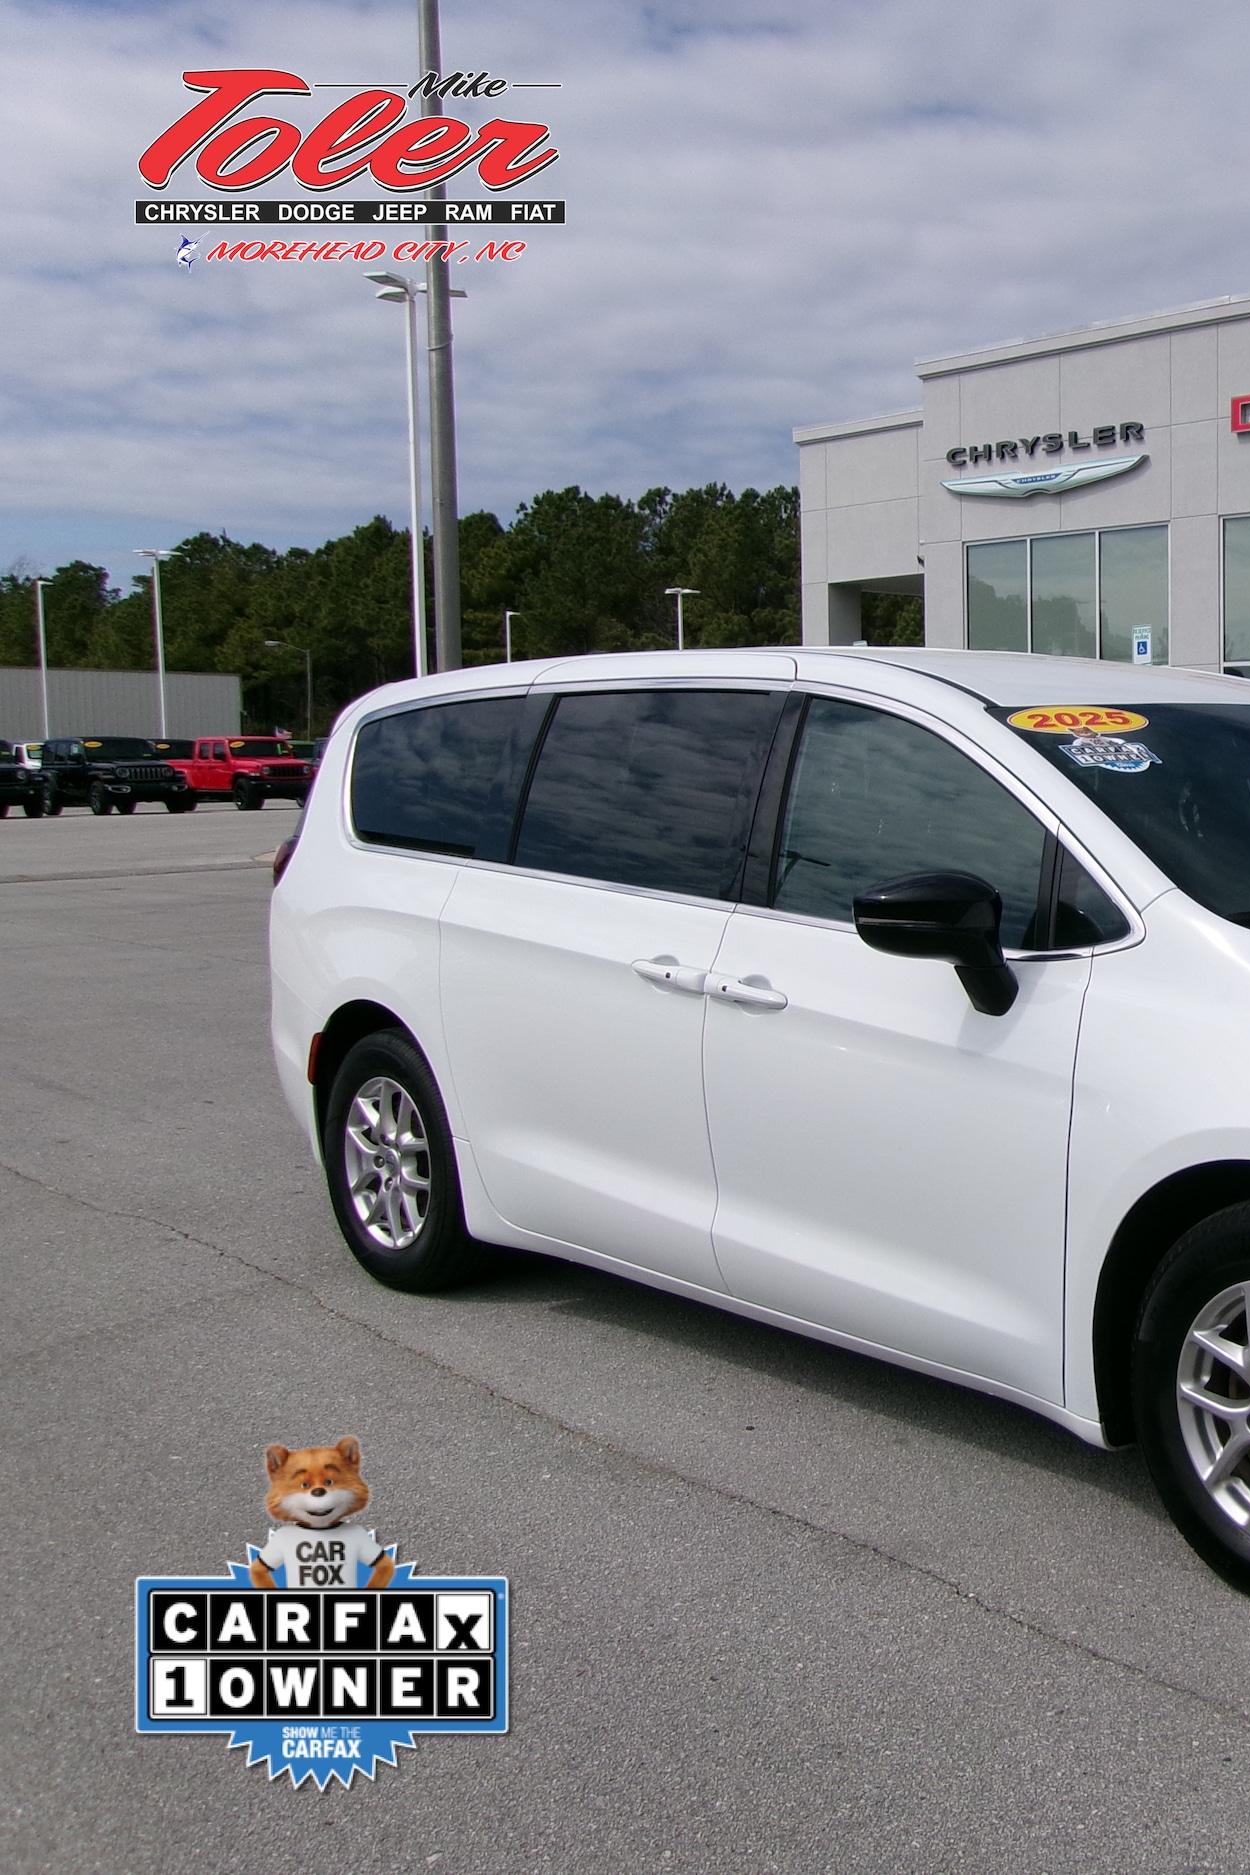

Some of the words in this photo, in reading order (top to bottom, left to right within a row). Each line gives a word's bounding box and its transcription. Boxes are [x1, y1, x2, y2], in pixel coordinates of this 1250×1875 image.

[945, 420, 1146, 467] CHRYSLER
[1015, 473, 1057, 485] CHRYSLER
[1027, 711, 1132, 729] 2025
[1070, 745, 1148, 757] CARFA
